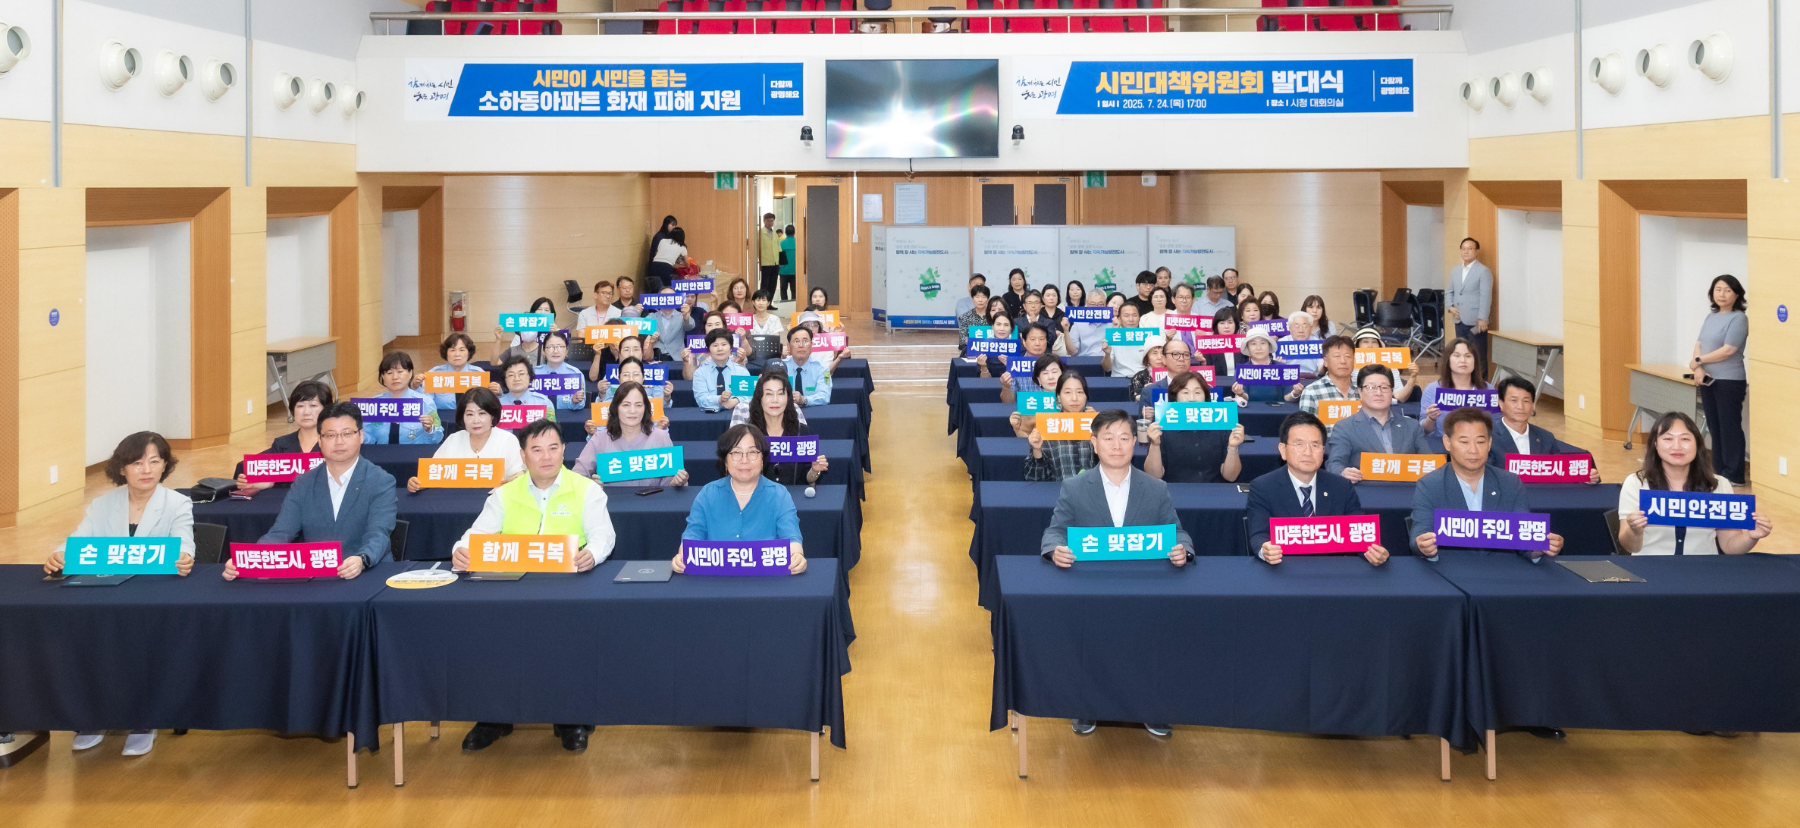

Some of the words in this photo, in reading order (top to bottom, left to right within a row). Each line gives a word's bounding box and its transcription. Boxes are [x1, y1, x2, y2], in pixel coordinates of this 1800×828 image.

[533, 70, 586, 87] 시민이
[592, 70, 645, 87] 시민을
[651, 70, 686, 87] 돕는
[1096, 71, 1263, 94] 시민대책위원회
[1272, 70, 1344, 93] 발대식
[479, 91, 600, 111] 소하동아파트
[607, 90, 647, 111] 화재
[654, 90, 694, 111] 피해
[701, 90, 741, 111] 지원
[1123, 99, 1144, 108] 2025.
[1148, 99, 1154, 108] 7.
[1187, 99, 1206, 108] 17:00
[1291, 98, 1307, 107] 시청
[1310, 98, 1344, 107] 대회의실
[674, 281, 711, 291] 시민안전망
[643, 295, 683, 306] 시민안전망
[1068, 309, 1111, 319] 시민안전망
[506, 317, 514, 327] 손
[519, 317, 547, 327] 맞잡기
[1166, 315, 1198, 328] 따뜻한도시,
[592, 329, 608, 339] 함께
[830, 334, 844, 347] 광명
[1113, 332, 1121, 341] 손
[971, 342, 1017, 352] 시민안전망
[1197, 338, 1233, 351] 따뜻한도시,
[1355, 352, 1376, 363] 함께
[1381, 352, 1402, 363] 극복
[433, 376, 454, 387] 함께
[460, 376, 481, 387] 극복
[1238, 369, 1261, 379] 시민이
[1263, 369, 1280, 380] 주인,
[1283, 369, 1298, 380] 광명
[544, 378, 561, 390] 주인,
[564, 377, 579, 389] 광명
[739, 380, 748, 391] 손
[1027, 397, 1037, 409] 손
[1437, 393, 1465, 406] 시민이
[1467, 394, 1487, 407] 주인,
[380, 403, 399, 416] 주인,
[403, 403, 421, 417] 광명
[526, 410, 544, 422] 광명
[1165, 407, 1178, 423] 손
[1186, 408, 1227, 422] 맞잡기
[1328, 405, 1351, 418] 함께
[1047, 418, 1073, 433] 함께
[770, 442, 792, 456] 주인,
[797, 441, 816, 455] 광명
[247, 459, 305, 475] 따뜻한도시,
[609, 458, 621, 474] 손
[629, 453, 672, 472] 맞잡기
[1372, 459, 1400, 474] 함께
[1408, 460, 1436, 475] 극복
[1509, 460, 1564, 476] 따뜻한도시,
[1569, 460, 1588, 475] 광명
[429, 464, 457, 480] 함께
[465, 464, 493, 480] 극복
[1648, 497, 1748, 520] 시민안전망
[1274, 524, 1344, 545] 따뜻한도시,
[1349, 522, 1376, 542] 광명
[1438, 517, 1478, 538] 시민이
[1482, 519, 1513, 540] 주인,
[1519, 521, 1546, 541] 광명
[1082, 535, 1098, 552] 손
[1108, 533, 1162, 551] 맞잡기
[80, 544, 97, 564] 손
[107, 545, 165, 564] 맞잡기
[483, 541, 519, 562] 함께
[528, 542, 564, 563] 극복
[687, 547, 724, 566] 시민이
[727, 548, 756, 567] 주인,
[761, 547, 787, 566] 광명
[235, 550, 305, 570] 따뜻한도시,
[310, 549, 338, 569] 광명
